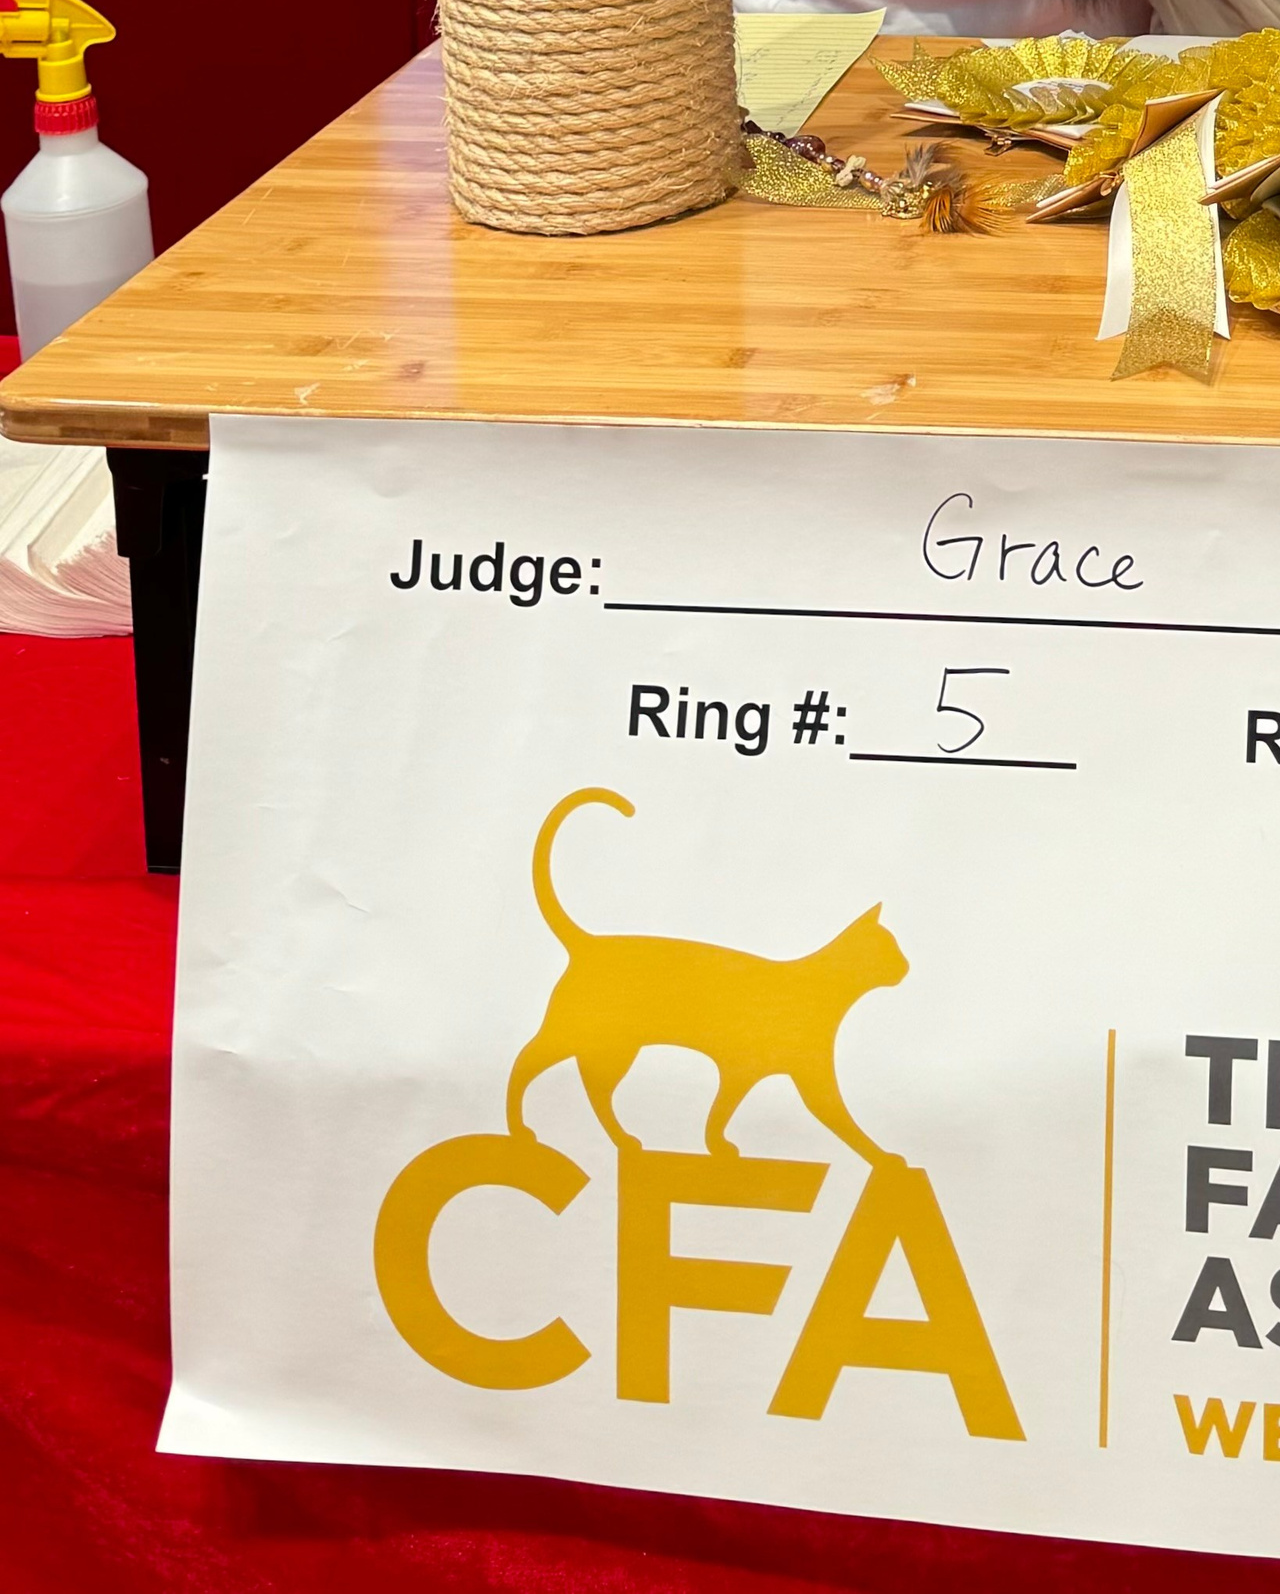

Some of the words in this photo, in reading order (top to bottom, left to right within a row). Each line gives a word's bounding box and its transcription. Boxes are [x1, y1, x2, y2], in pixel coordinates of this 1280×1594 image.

[391, 540, 600, 607] Judge:
[922, 493, 1144, 592] Grace
[629, 685, 769, 756] Ring
[793, 691, 846, 744] #:
[936, 667, 1010, 753] 5
[373, 1133, 1027, 1441] CFA
